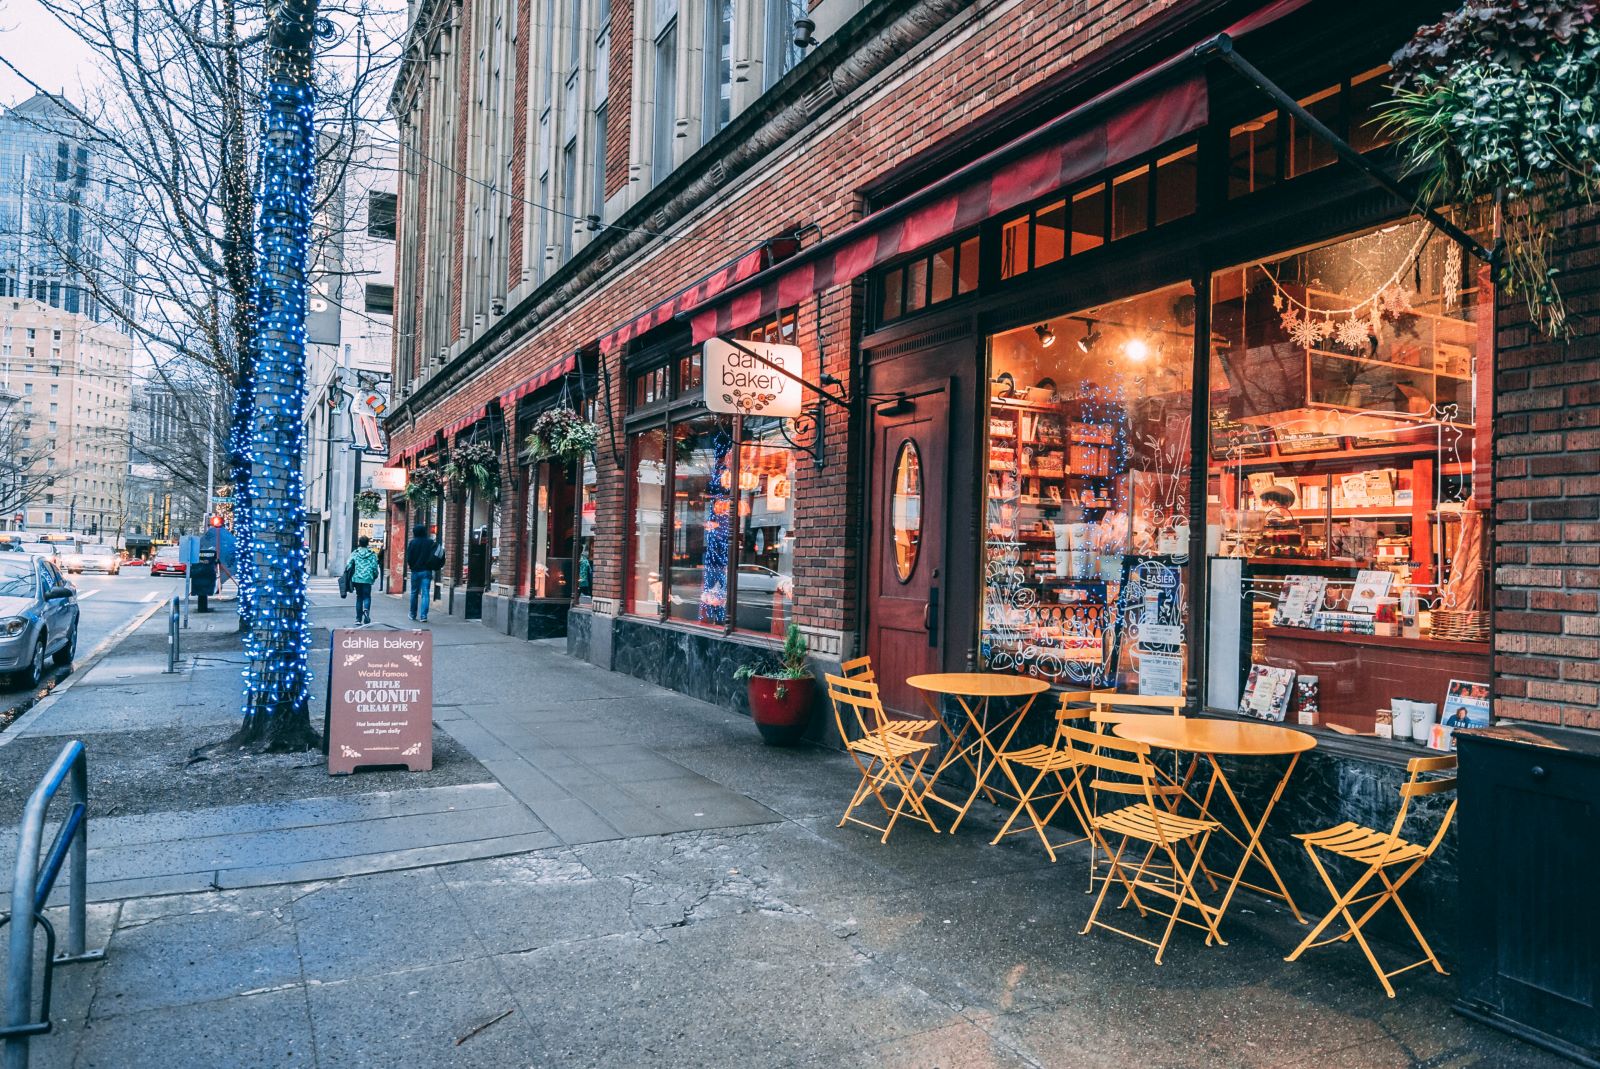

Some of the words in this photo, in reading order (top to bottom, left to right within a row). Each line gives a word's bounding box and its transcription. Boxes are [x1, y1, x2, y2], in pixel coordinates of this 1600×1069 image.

[722, 365, 786, 394] bakery
[1146, 574, 1174, 584] EASIER
[342, 637, 379, 649] dahlia
[383, 637, 424, 651] bakery
[357, 669, 381, 678] World
[382, 669, 409, 678] Famous
[365, 680, 401, 689] TRIPLE
[344, 689, 420, 703] COCONUT
[356, 704, 390, 712] CREAM
[392, 703, 408, 712] PIE
